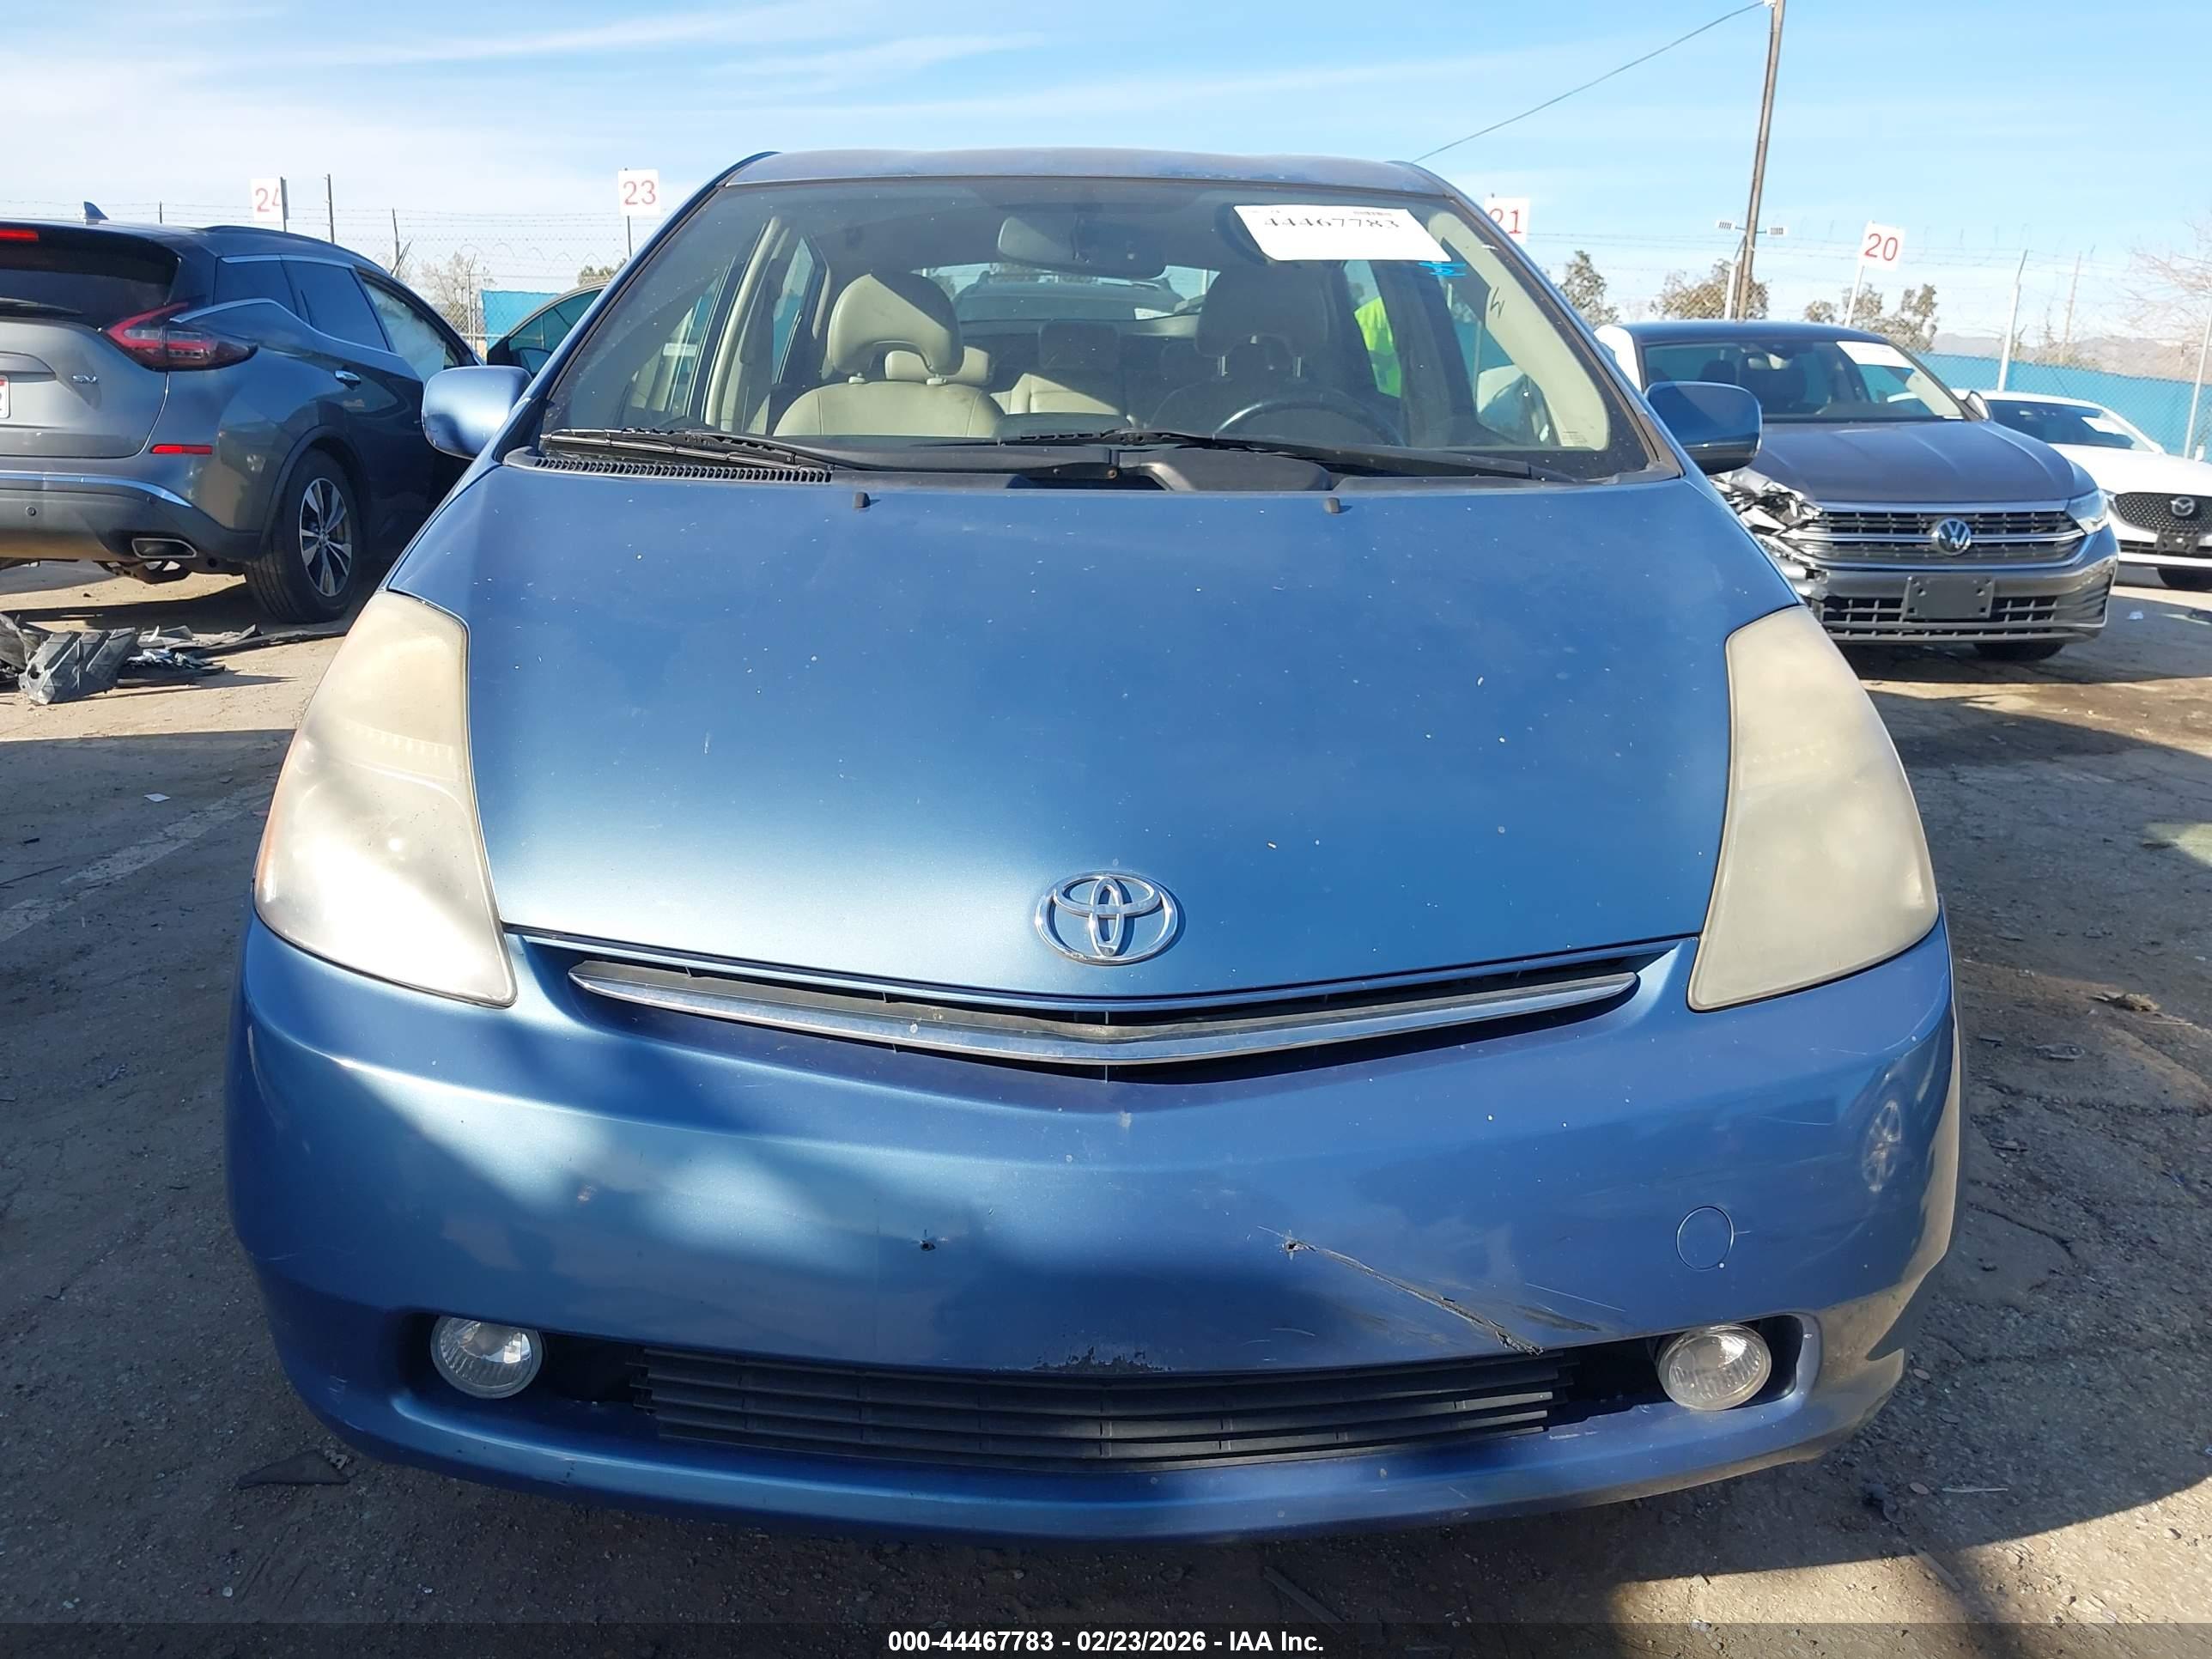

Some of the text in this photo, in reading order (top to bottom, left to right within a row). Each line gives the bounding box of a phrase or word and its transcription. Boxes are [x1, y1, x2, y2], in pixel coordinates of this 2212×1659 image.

[623, 180, 656, 205] 23
[1264, 217, 1401, 229] 44467783
[1864, 233, 1899, 262] 20
